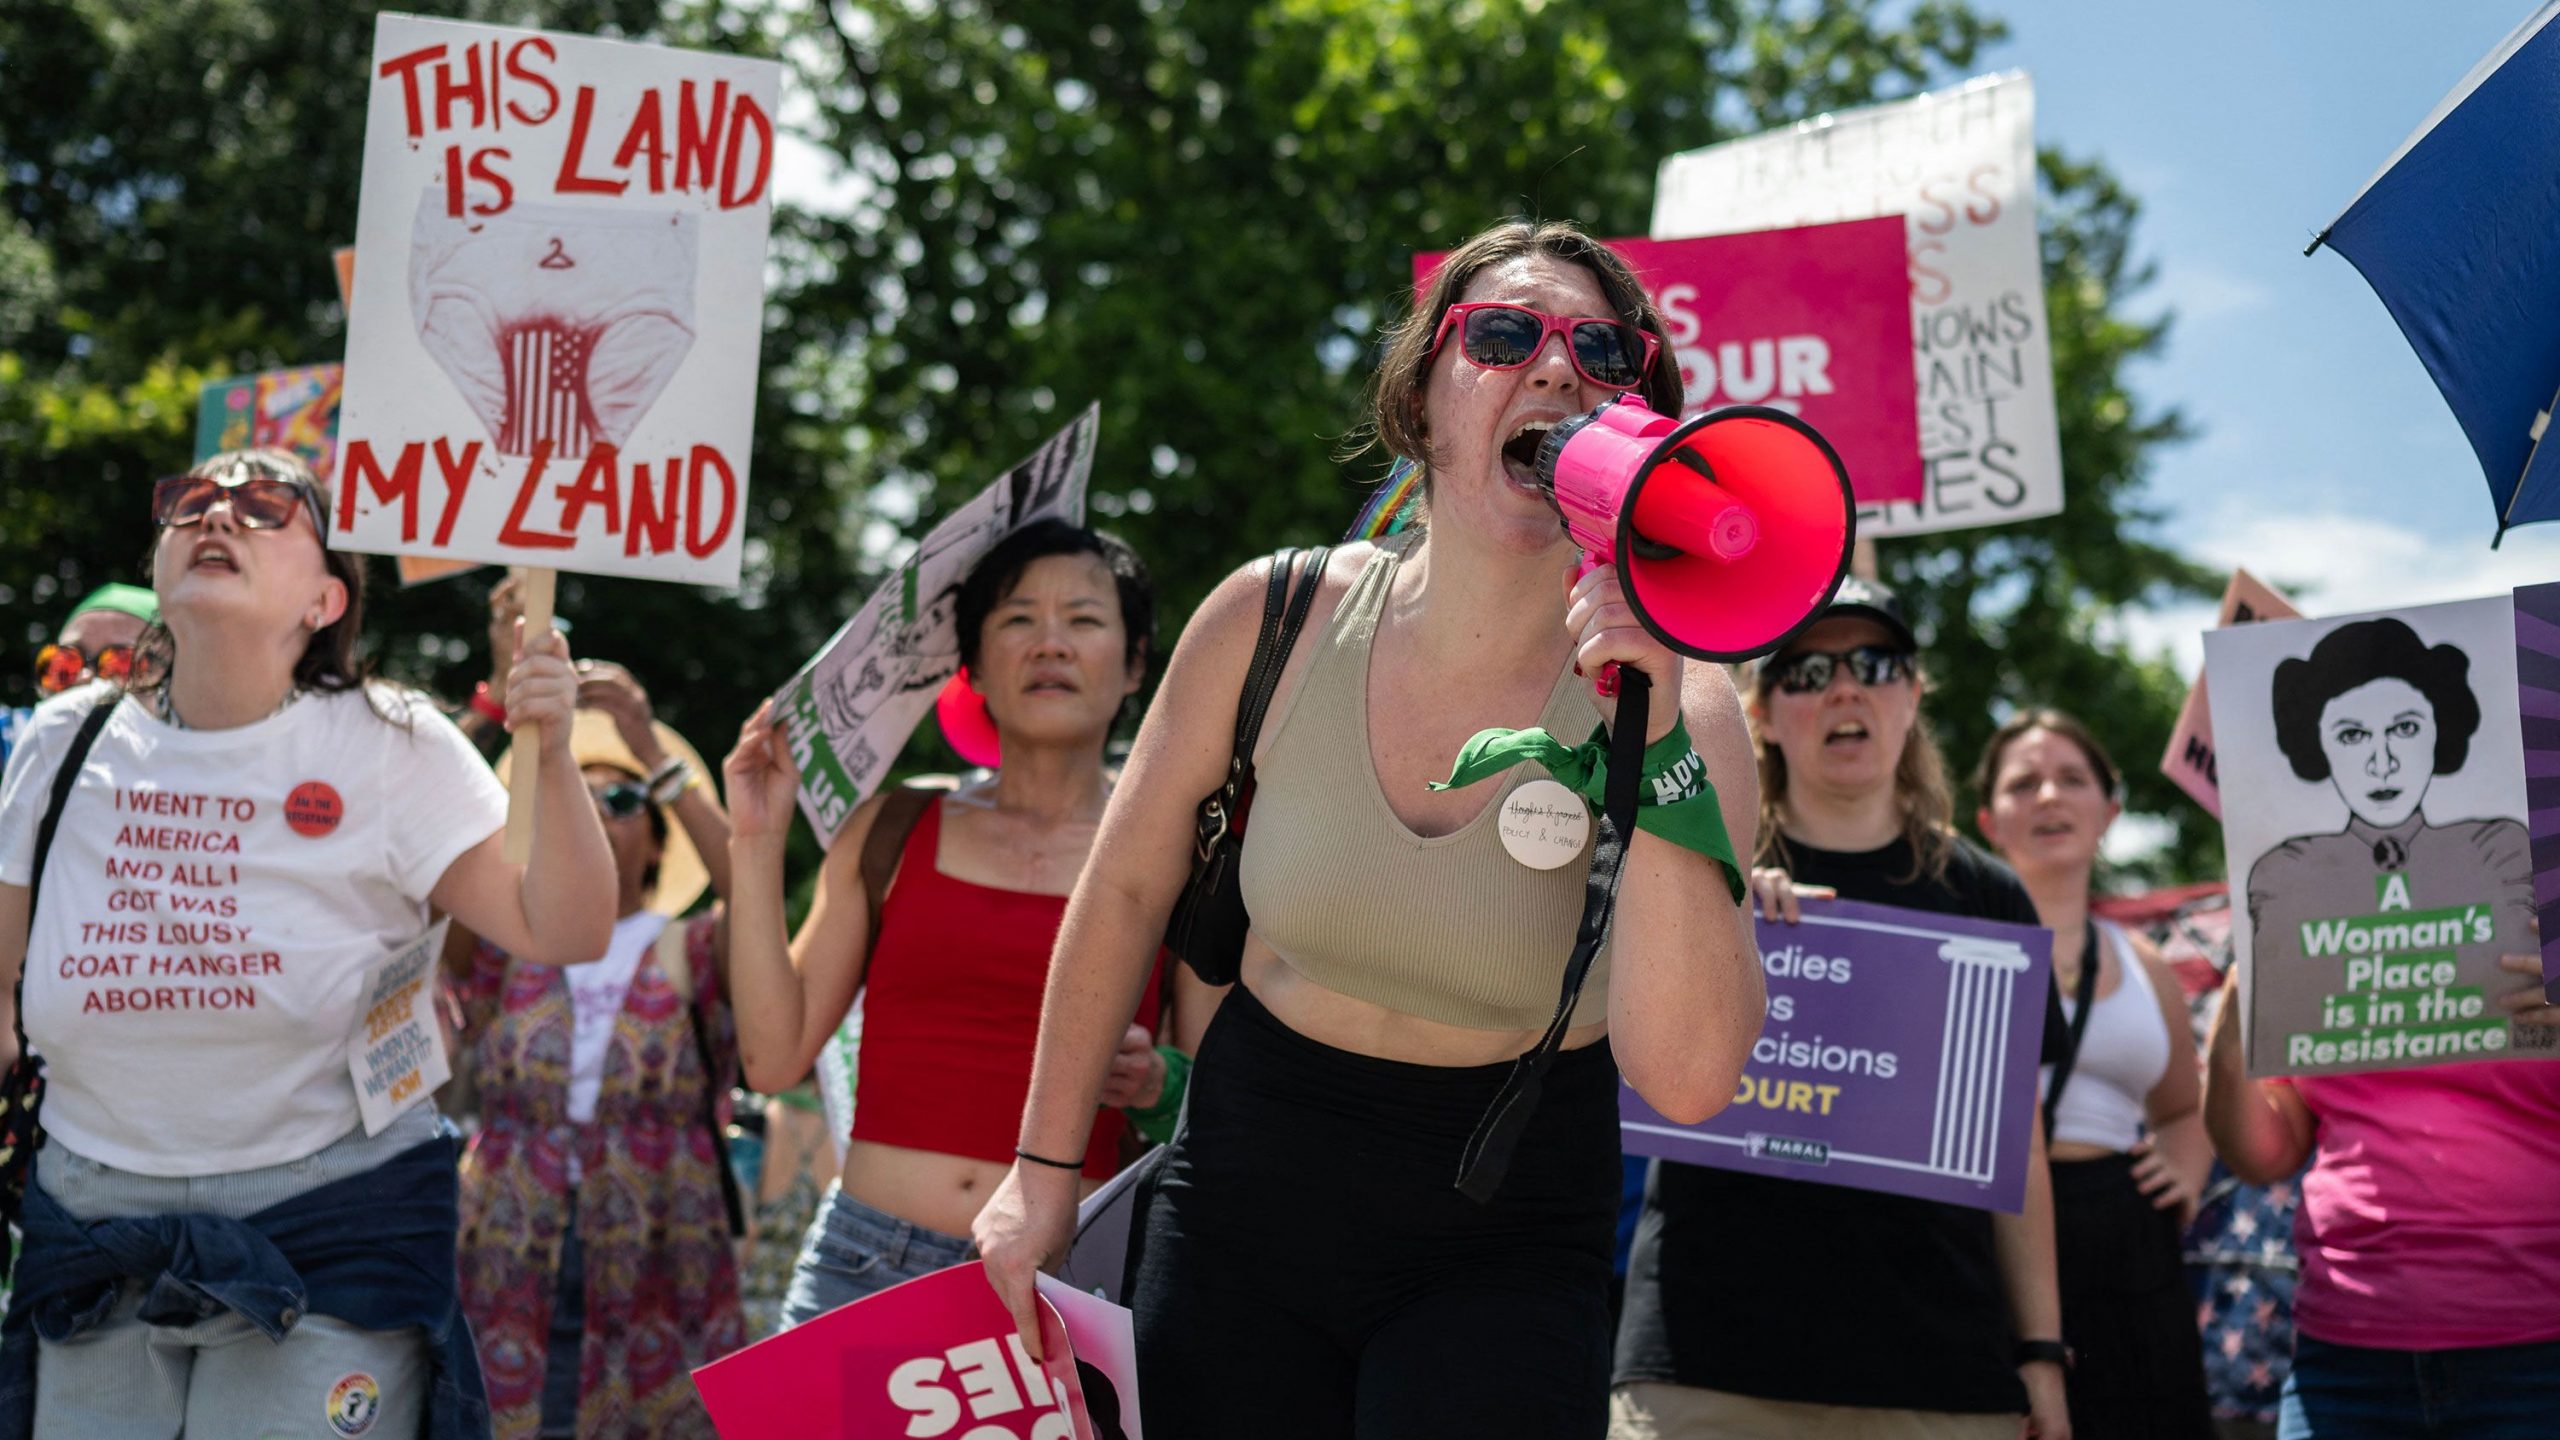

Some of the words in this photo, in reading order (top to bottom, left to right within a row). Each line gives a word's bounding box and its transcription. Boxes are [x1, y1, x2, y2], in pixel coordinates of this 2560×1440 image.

[380, 37, 559, 138] THIS
[554, 79, 773, 210] LAND
[446, 145, 514, 218] IS
[337, 437, 483, 547] MY
[497, 438, 737, 560] LAND
[115, 789, 121, 810] I
[129, 791, 208, 817] WENT
[216, 797, 255, 821] TO
[810, 769, 847, 828] us
[115, 824, 240, 853] AMERICA
[1502, 826, 1530, 839] POLICY
[1539, 828, 1547, 842] &
[1553, 836, 1583, 849] CHANGE
[107, 857, 163, 881] AND
[170, 863, 222, 887] ALL
[230, 864, 238, 884] I
[108, 890, 160, 912] GOT
[170, 895, 237, 917] WAS
[2380, 874, 2411, 912] A
[80, 923, 147, 944] THIS
[157, 923, 251, 945] LOUSY
[2301, 906, 2492, 957] Woman's
[59, 954, 140, 979] COAT
[149, 952, 282, 976] HANGER
[1761, 946, 1852, 984] dies
[2347, 954, 2456, 992] Place
[83, 985, 255, 1014] ABORTION
[2324, 993, 2356, 1029] is
[2368, 991, 2405, 1025] in
[2417, 987, 2484, 1022] the
[1752, 1032, 1898, 1079] cisions
[2288, 1027, 2507, 1066] Resistance
[1732, 1074, 1841, 1116] OURT
[1769, 1140, 1825, 1160] NARAL
